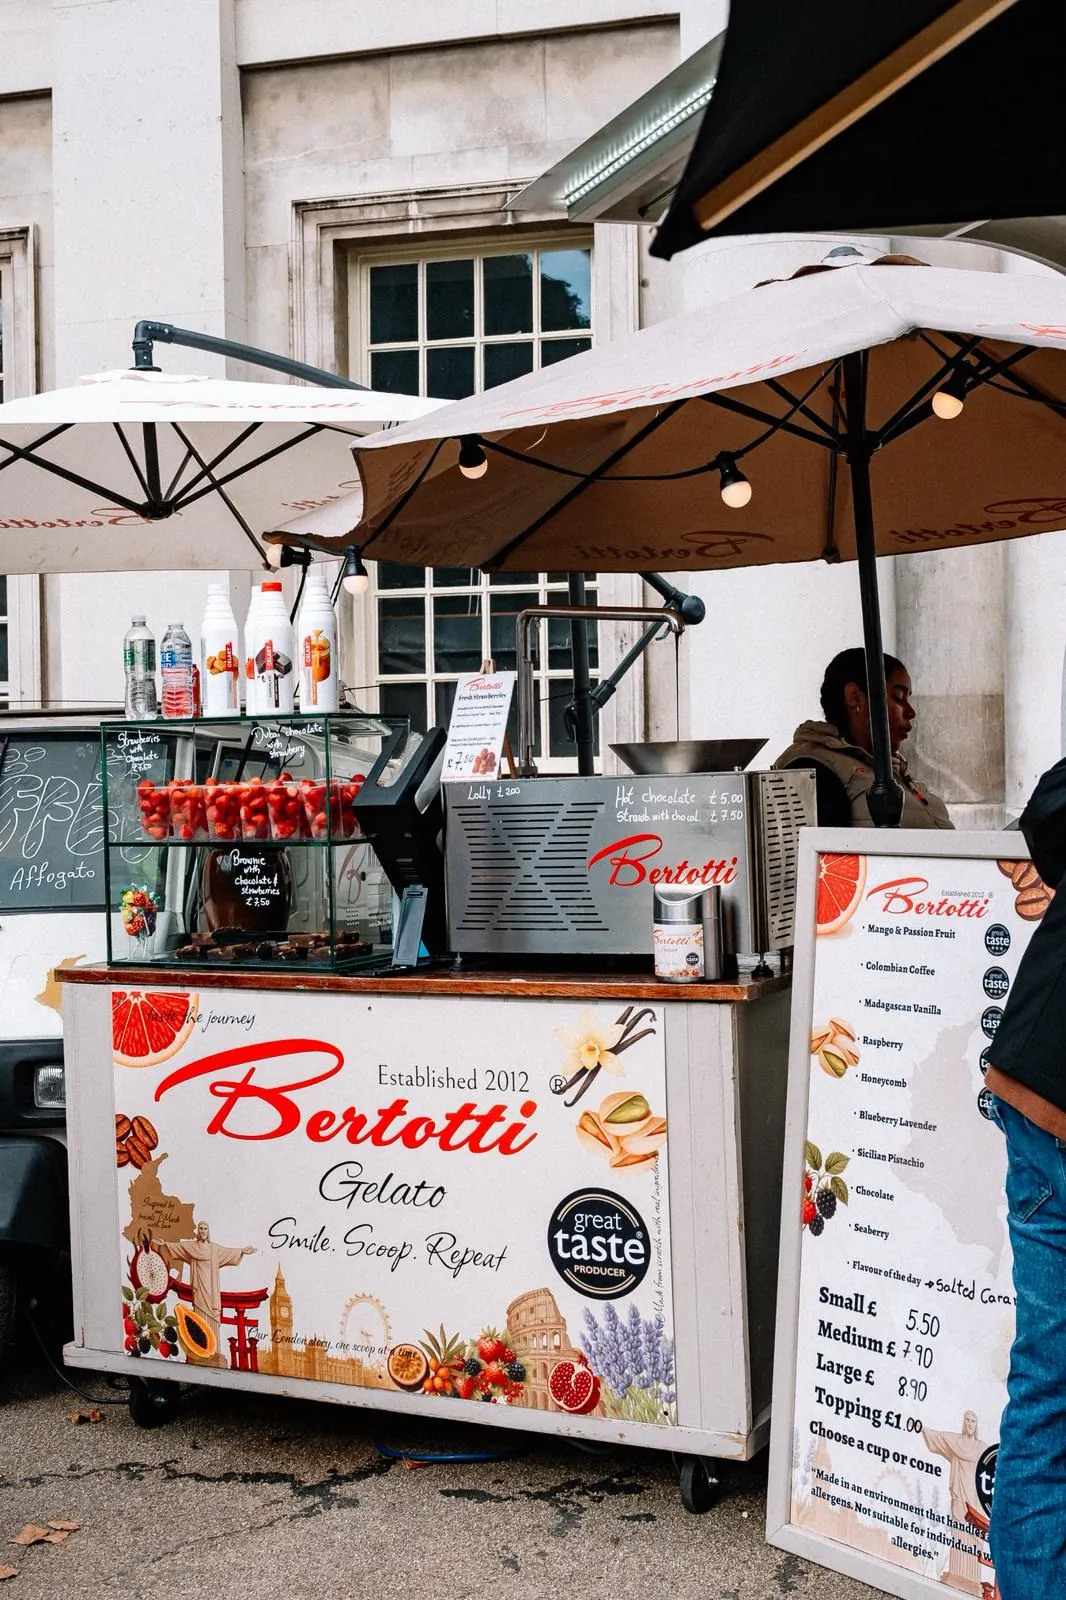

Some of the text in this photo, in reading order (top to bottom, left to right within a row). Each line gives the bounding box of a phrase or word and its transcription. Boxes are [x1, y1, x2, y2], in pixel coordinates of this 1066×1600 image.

[251, 723, 325, 744] Dubai chocolate
[267, 740, 282, 748] with
[615, 785, 634, 808] Hot
[642, 786, 696, 804] chocolate
[651, 808, 669, 821] with
[230, 849, 266, 866] Brownie
[588, 833, 738, 886] Bertotti
[9, 861, 96, 890] Affogato
[235, 875, 272, 885] chocolate
[244, 865, 260, 874] with
[866, 877, 989, 918] Bertotti
[941, 890, 971, 898] Established
[867, 924, 956, 939] Mango & Passion Fruit
[986, 936, 1010, 946] taste
[866, 961, 936, 976] Colombian Coffee
[984, 979, 1009, 990] taste
[864, 998, 942, 1016] Madagascan Vanilla
[201, 1010, 256, 1033] journey
[982, 1018, 1000, 1028] tast
[862, 1036, 904, 1051] Raspberry
[378, 1064, 477, 1090] Established
[485, 1068, 529, 1092] 2012
[861, 1073, 907, 1088] Honeycomb
[154, 1038, 538, 1156] Bertotti
[859, 1110, 938, 1132] Blueberry Lavender
[857, 1148, 925, 1169] Sicilian Pistachio
[319, 1161, 448, 1210] Gelato
[855, 1186, 894, 1202] Chocolate
[574, 1213, 622, 1233] great
[853, 1223, 890, 1240] Seaberry
[268, 1217, 507, 1279] Smile. Scoop. Repeat
[573, 1264, 625, 1277] PRODUCER
[852, 1260, 1016, 1305] Flavour of the day Salted Cara
[819, 1286, 940, 1338] Small £ 5.50
[247, 1327, 268, 1340] Our
[271, 1329, 308, 1345] London
[335, 1342, 350, 1350] one
[351, 1343, 375, 1357] scoop
[377, 1345, 388, 1354] at
[399, 1347, 418, 1359] time
[817, 1319, 883, 1354] Medium
[886, 1341, 896, 1358] £
[816, 1352, 927, 1402] Large £ 8.90
[814, 1386, 923, 1434] Topping £1.00
[810, 1420, 942, 1477] Choose a cup or cone
[841, 1477, 851, 1489] in
[851, 1483, 862, 1494] an
[863, 1487, 924, 1519] environment
[925, 1508, 945, 1525] that
[947, 1514, 985, 1540] handles
[811, 1486, 854, 1510] allergens.
[854, 1501, 871, 1516] Not
[872, 1508, 909, 1531] suitable
[910, 1522, 926, 1537] for
[926, 1528, 982, 1558] individuals
